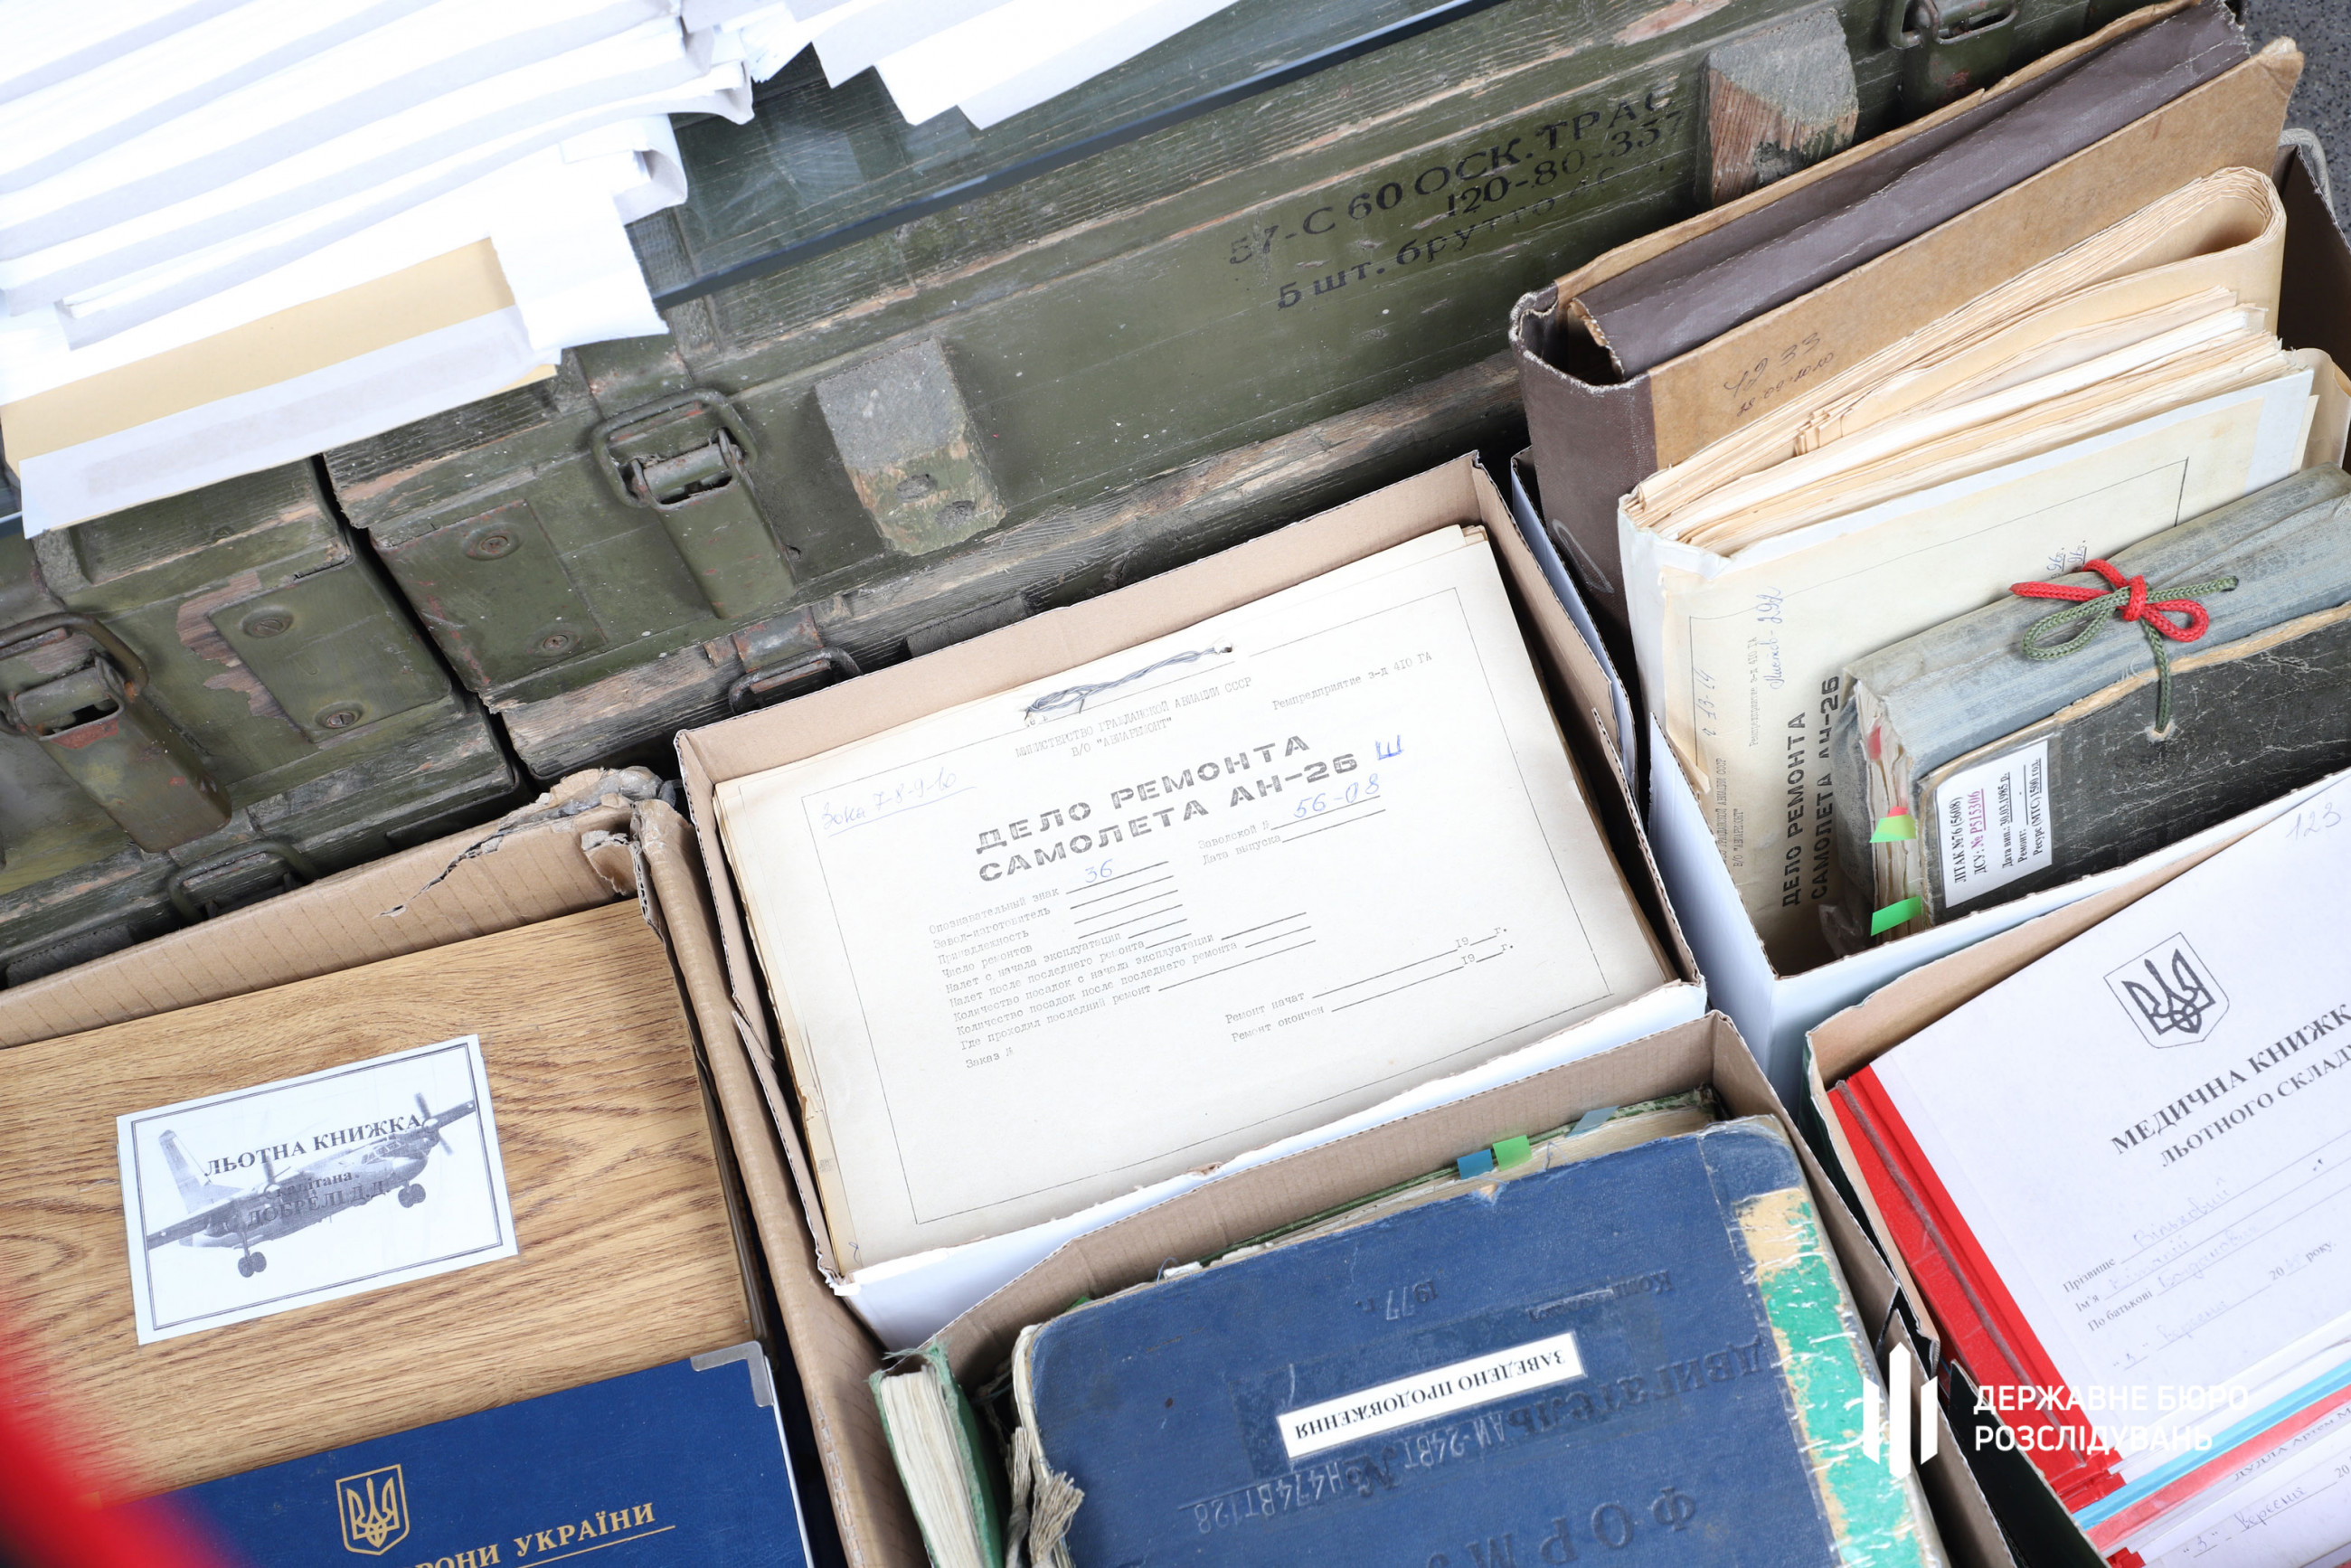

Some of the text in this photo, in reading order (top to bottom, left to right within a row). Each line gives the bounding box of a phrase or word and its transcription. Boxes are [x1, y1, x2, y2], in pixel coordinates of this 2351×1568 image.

[1348, 182, 1406, 221] 60
[1274, 281, 1303, 311] 5
[1312, 258, 1387, 298] шт.
[1225, 677, 1251, 694] СССР
[977, 737, 1308, 855] ДЕЛО РЕМОНТА
[980, 754, 1357, 882] САМОЛЕТА АН-26
[1292, 774, 1381, 820] 56-08
[1781, 711, 1808, 907] ДЕЛО РЕМОНТА
[1198, 825, 1258, 849] Заводской
[1203, 836, 1284, 866] Дата выпуска
[1810, 774, 1833, 901] САМОЛЕТА
[1083, 859, 1114, 883] 36
[1953, 850, 1967, 883] ЛІТАК
[1032, 886, 1060, 905] знак
[941, 963, 975, 978] Число
[946, 978, 979, 994] Налет
[998, 959, 1037, 977] начала
[1043, 933, 1121, 963] эксплуатации
[949, 992, 983, 1007] Налет
[989, 980, 1022, 996] после
[1028, 958, 1093, 984] последнего
[953, 997, 1020, 1022] Количество
[1025, 979, 1072, 1000] посадок
[1091, 962, 1129, 980] начала
[1136, 934, 1214, 965] эксплуатации
[957, 942, 1238, 1036] Количество посадок после последнего ремонта
[1225, 1006, 1266, 1025] Ремонт
[1271, 993, 1305, 1010] начат
[960, 986, 1151, 1051] Где проходил последний ремонт
[1231, 1024, 1271, 1043] Ремонт
[1279, 1006, 1325, 1027] окончен
[966, 1053, 1000, 1069] Заказ
[2110, 1072, 2248, 1155] МЕДИЧНА
[2162, 1044, 2351, 1167] ЛЬОТНОГО СКЛАД
[203, 1113, 422, 1177] ЛЬОТНА КНИЖКА
[2063, 1257, 2117, 1293] Прізвище
[2268, 1265, 2286, 1282] 20
[2087, 1288, 2154, 1333] По батькові
[1296, 1346, 1566, 1439] ЗАВЕДЕНО ПРОДОВЖЕННЯ
[513, 1502, 656, 1557] УКРАЇНИ
